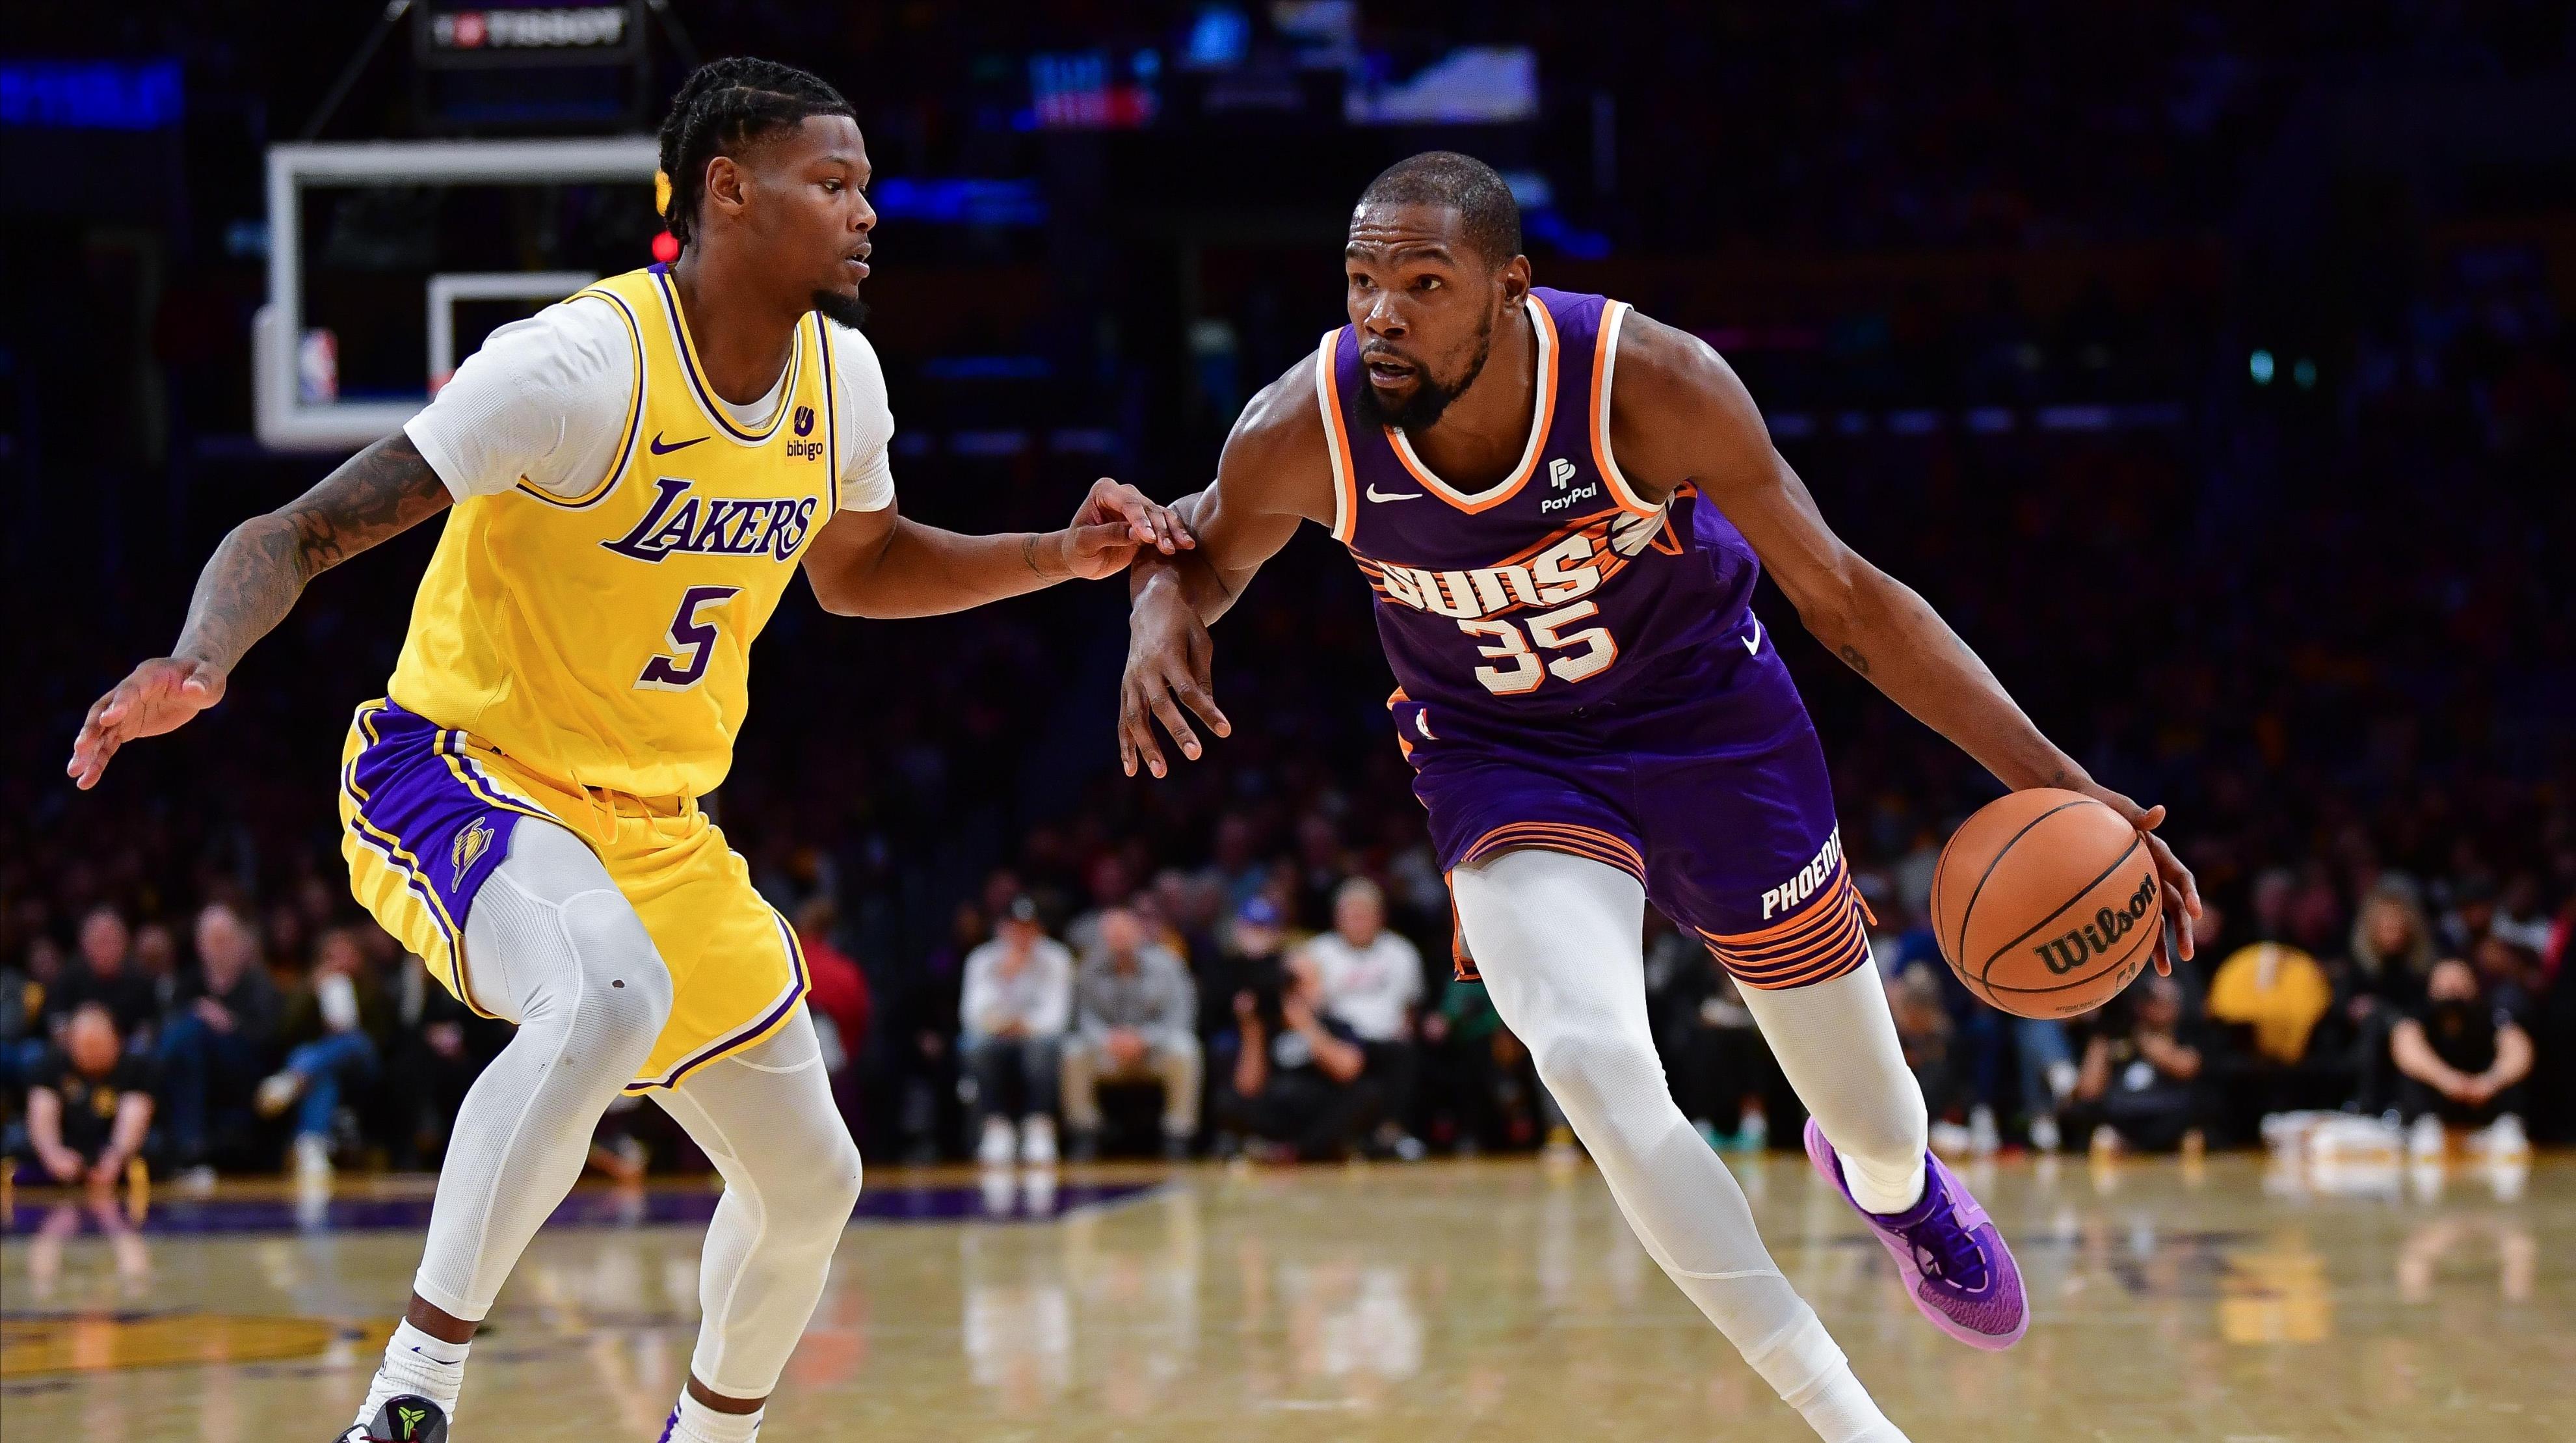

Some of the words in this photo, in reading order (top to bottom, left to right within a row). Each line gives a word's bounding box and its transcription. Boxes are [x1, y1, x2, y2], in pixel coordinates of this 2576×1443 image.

[787, 440, 823, 461] bibigo
[597, 476, 817, 564] LAKERS
[1541, 482, 1597, 514] PayPal
[631, 585, 746, 693] 5
[1457, 600, 1618, 695] 35
[2032, 872, 2157, 975] Wilson
